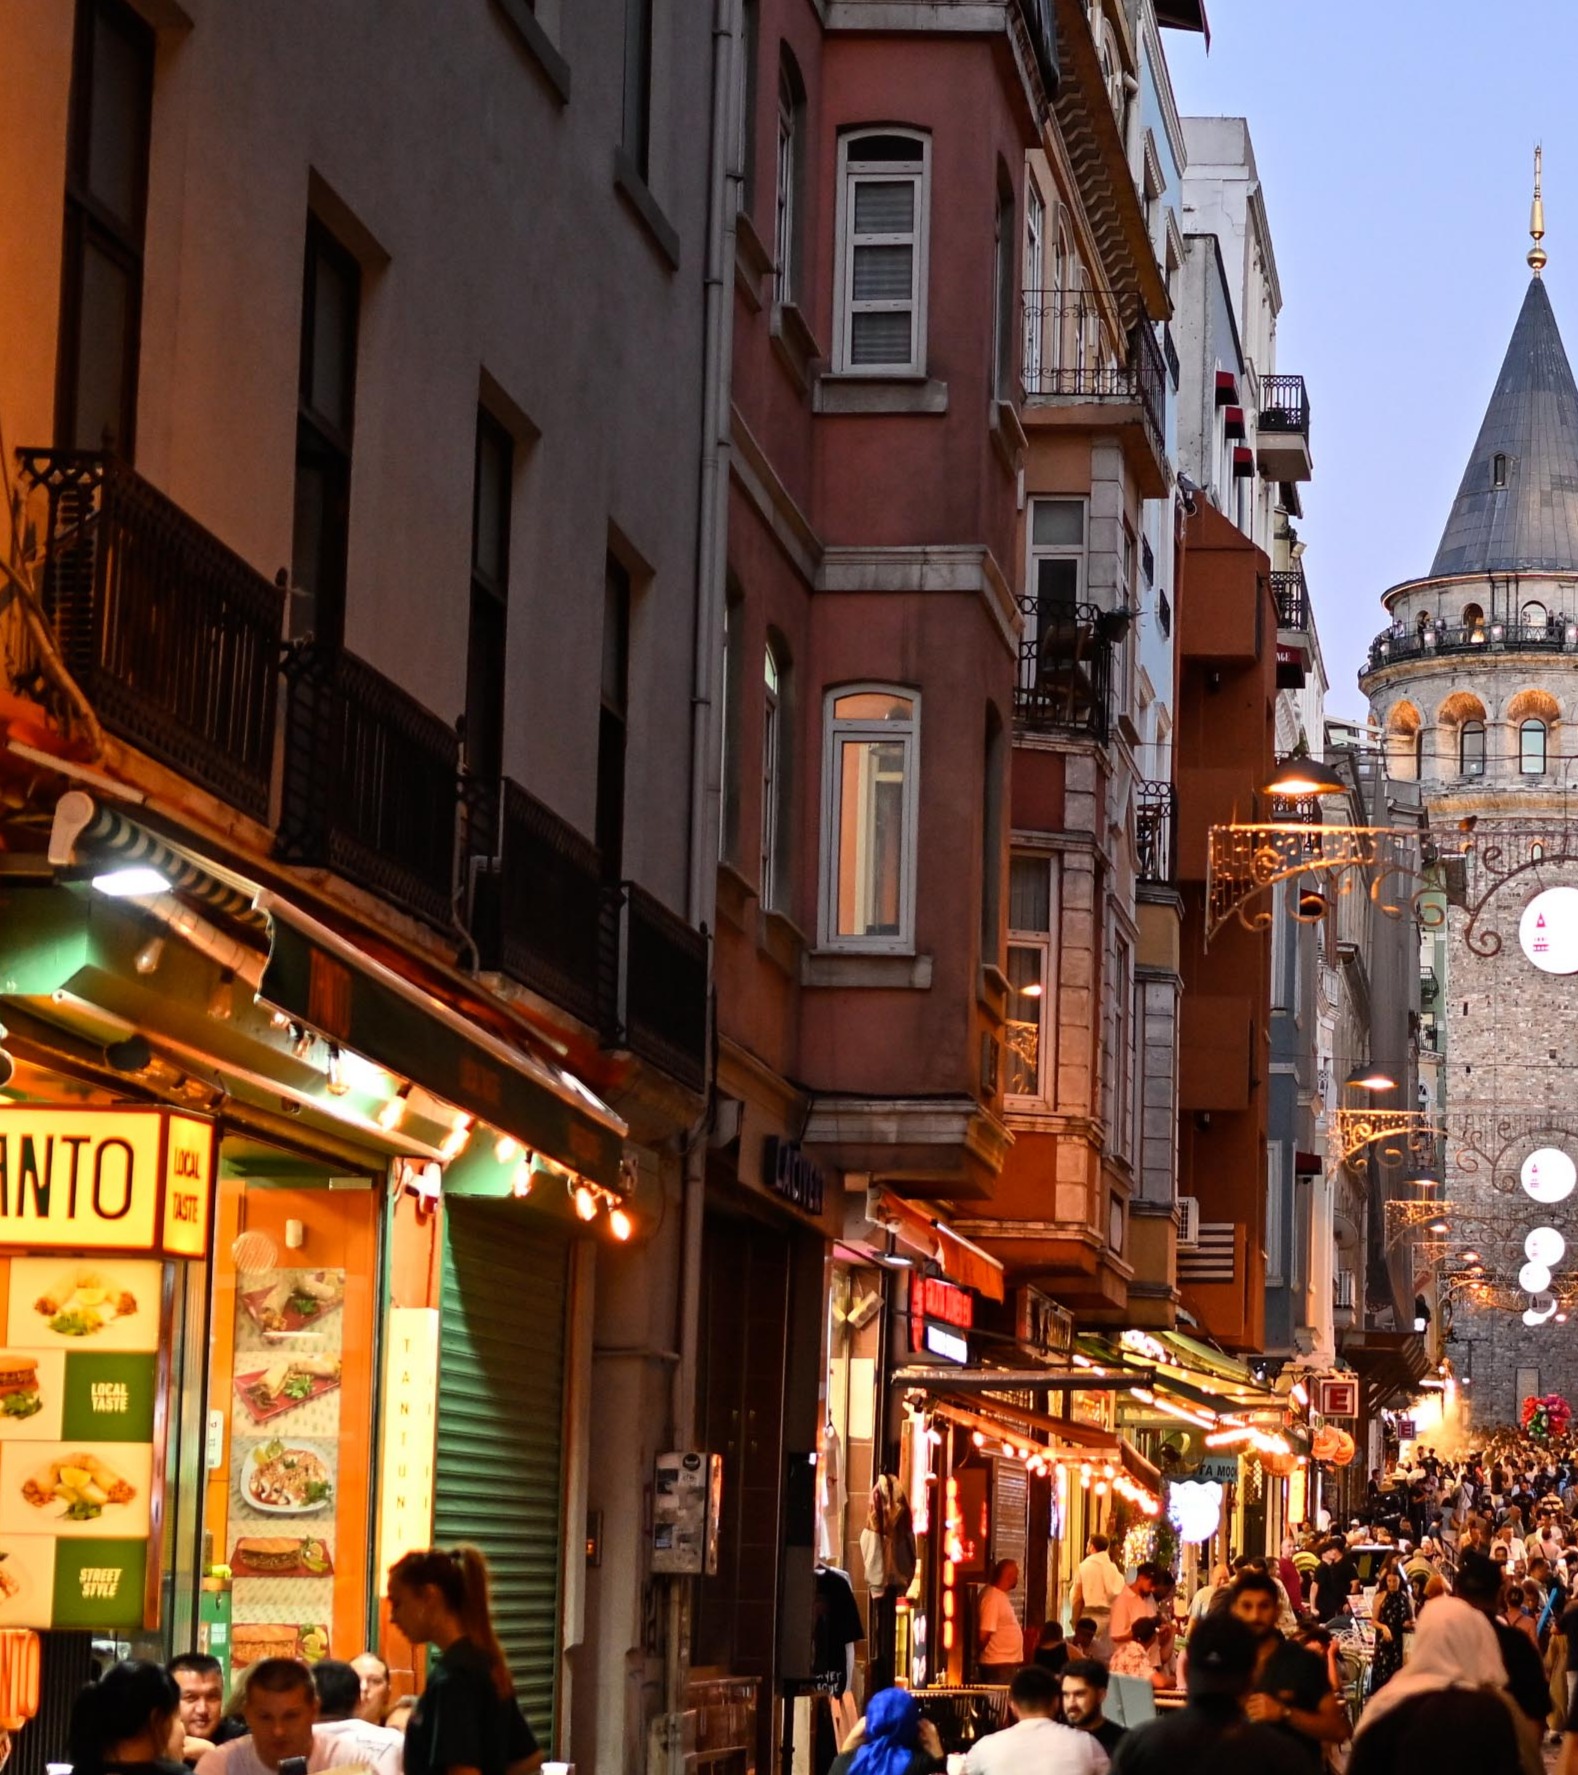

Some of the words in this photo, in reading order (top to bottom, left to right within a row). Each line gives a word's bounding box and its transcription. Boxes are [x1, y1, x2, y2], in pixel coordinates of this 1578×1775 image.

[174, 1146, 201, 1180] LOCAL
[173, 1191, 199, 1224] TASTE
[91, 1382, 128, 1396] LOCAL
[92, 1396, 128, 1411] TASTE
[1330, 1387, 1348, 1410] E
[1401, 1422, 1412, 1437] E
[79, 1568, 122, 1583] STREET
[82, 1582, 119, 1598] STYLE
